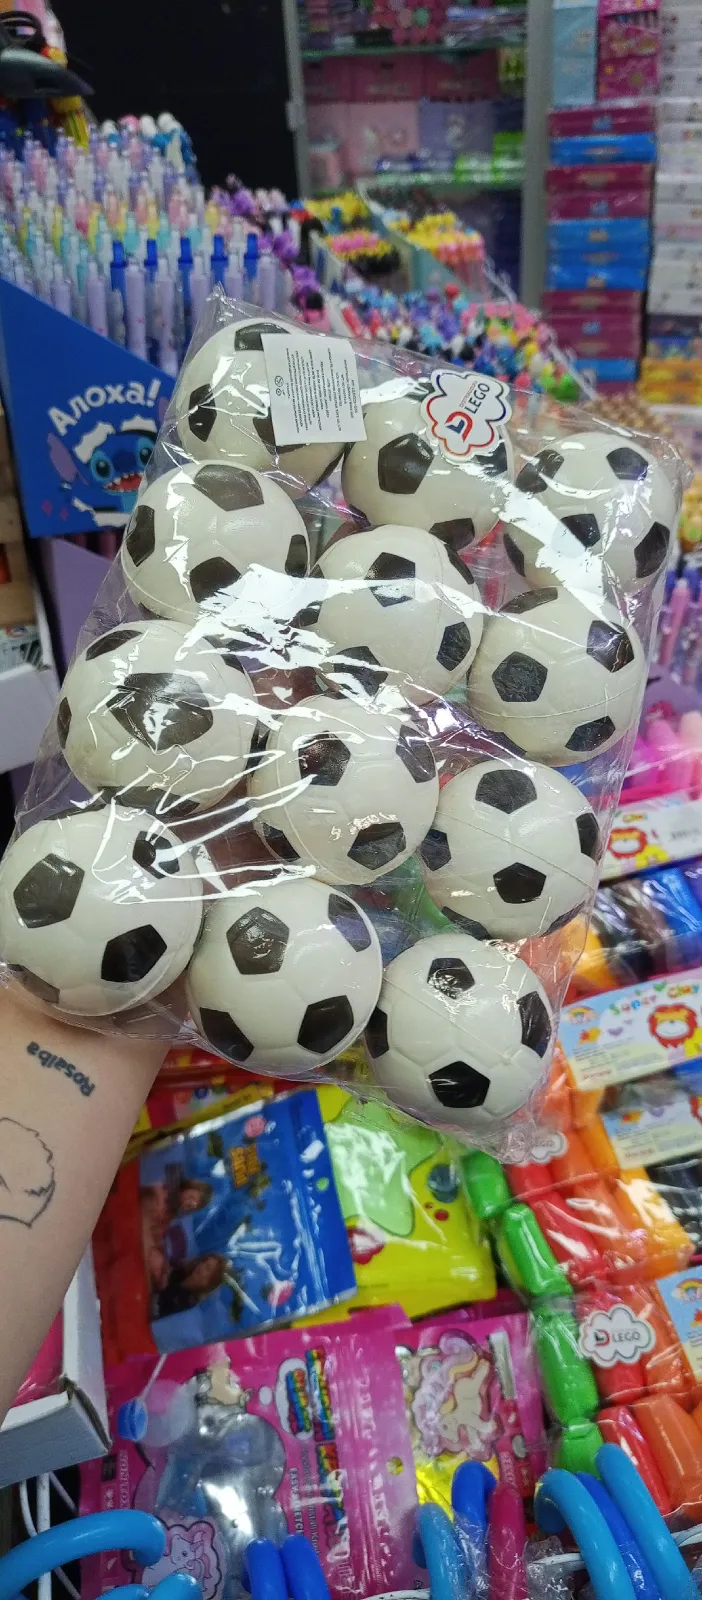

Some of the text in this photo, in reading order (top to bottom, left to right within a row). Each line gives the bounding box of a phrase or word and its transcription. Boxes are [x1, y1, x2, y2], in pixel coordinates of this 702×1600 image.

[48, 378, 161, 436] Алоха!
[464, 382, 490, 414] LEGO
[26, 1041, 96, 1096] Rosalba
[612, 1331, 641, 1342] LEGO
